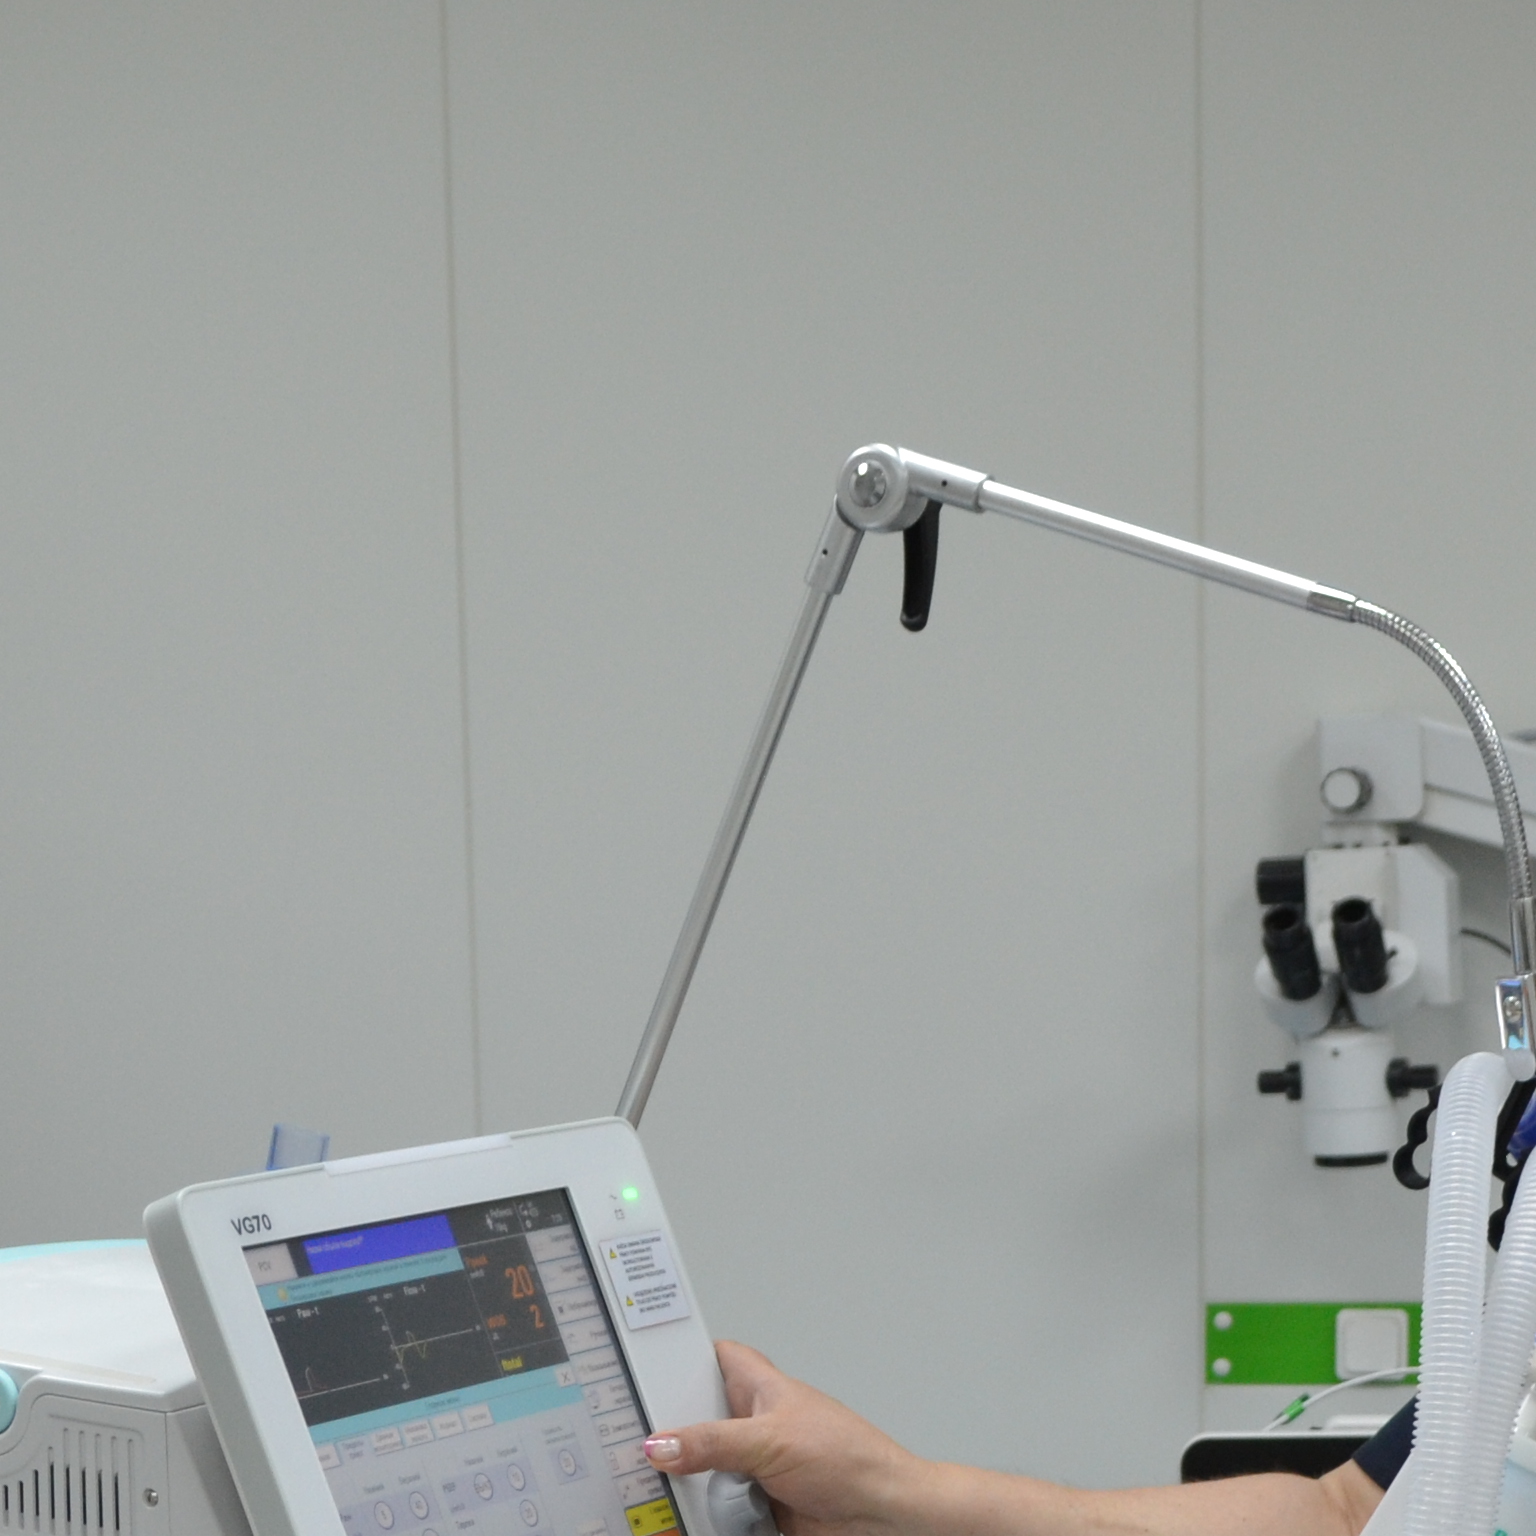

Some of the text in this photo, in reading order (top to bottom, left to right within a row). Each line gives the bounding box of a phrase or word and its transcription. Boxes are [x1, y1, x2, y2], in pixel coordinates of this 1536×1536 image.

[231, 1214, 272, 1236] VG70
[504, 1264, 538, 1300] 20
[528, 1303, 546, 1330] 2
